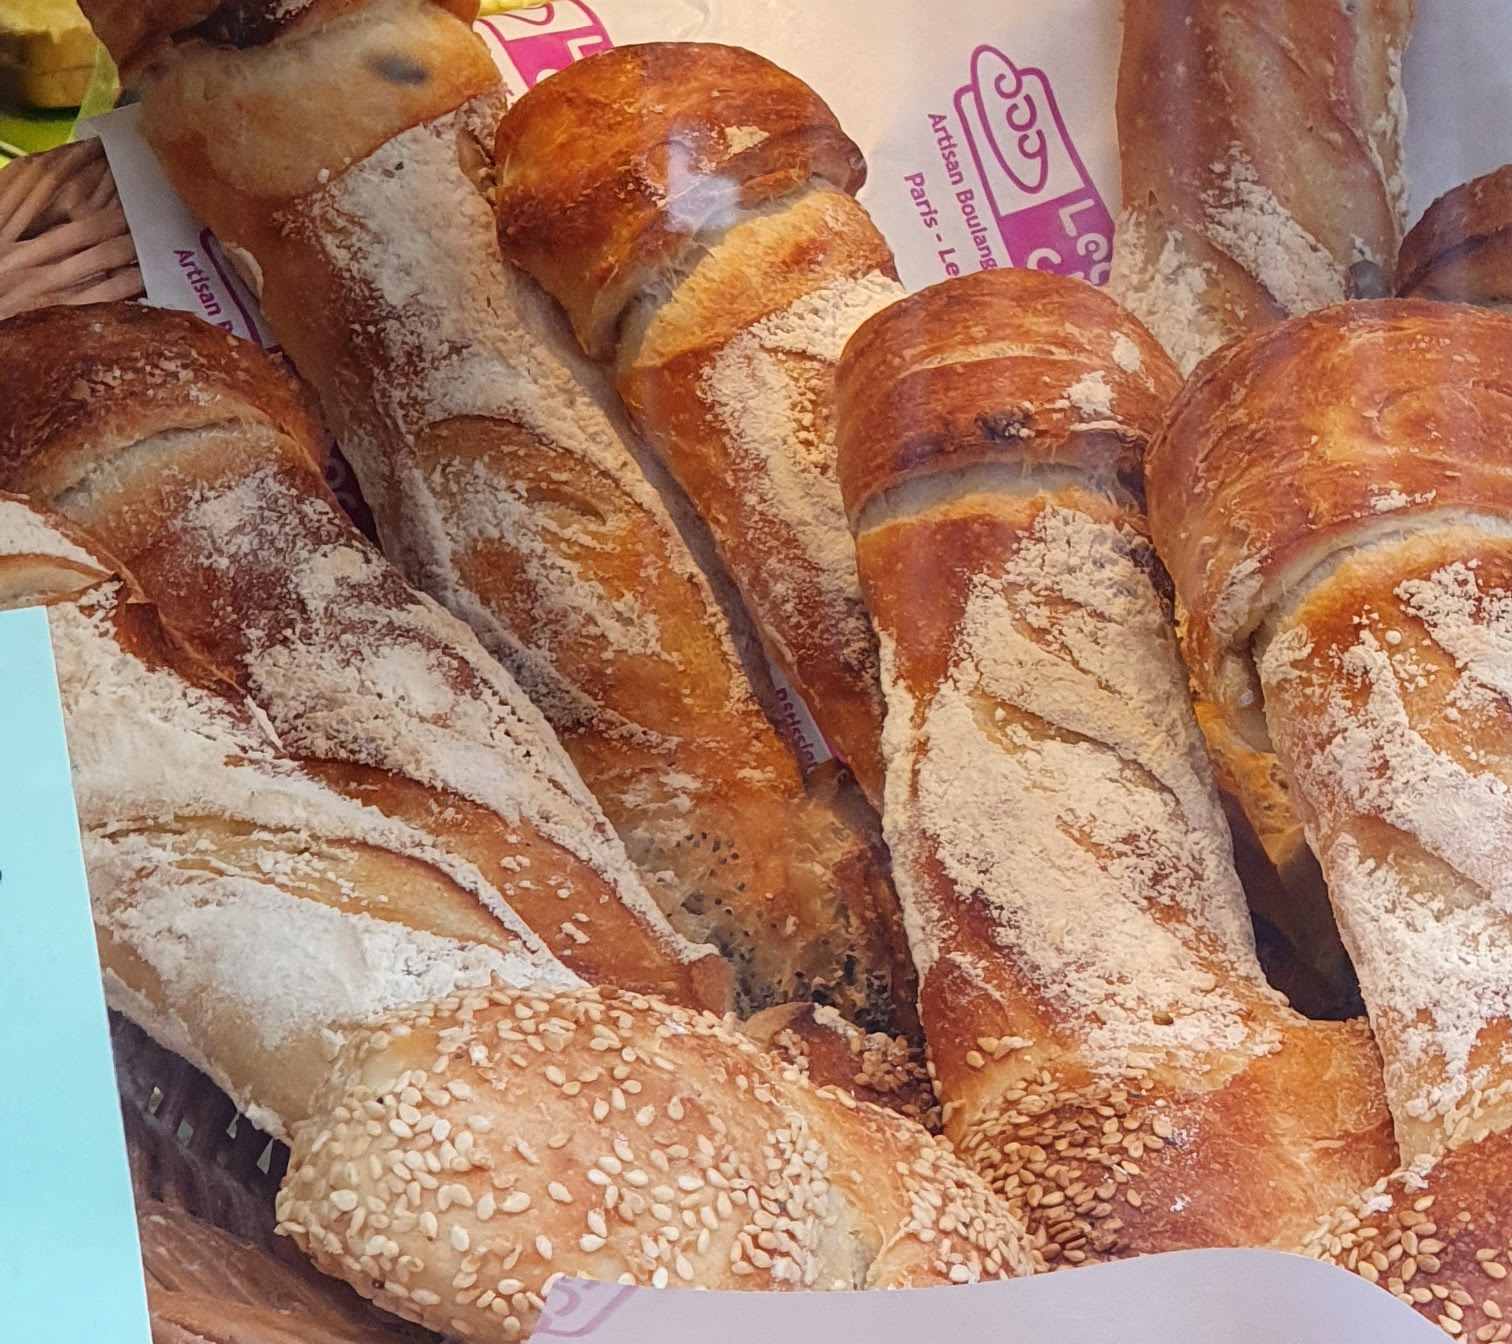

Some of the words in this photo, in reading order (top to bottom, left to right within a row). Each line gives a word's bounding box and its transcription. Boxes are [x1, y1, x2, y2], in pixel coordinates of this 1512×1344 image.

[904, 172, 939, 229] Paris
[938, 247, 961, 277] Le
[927, 113, 964, 186] Artisan
[955, 188, 998, 271] Boulang
[173, 250, 222, 316] Artisan
